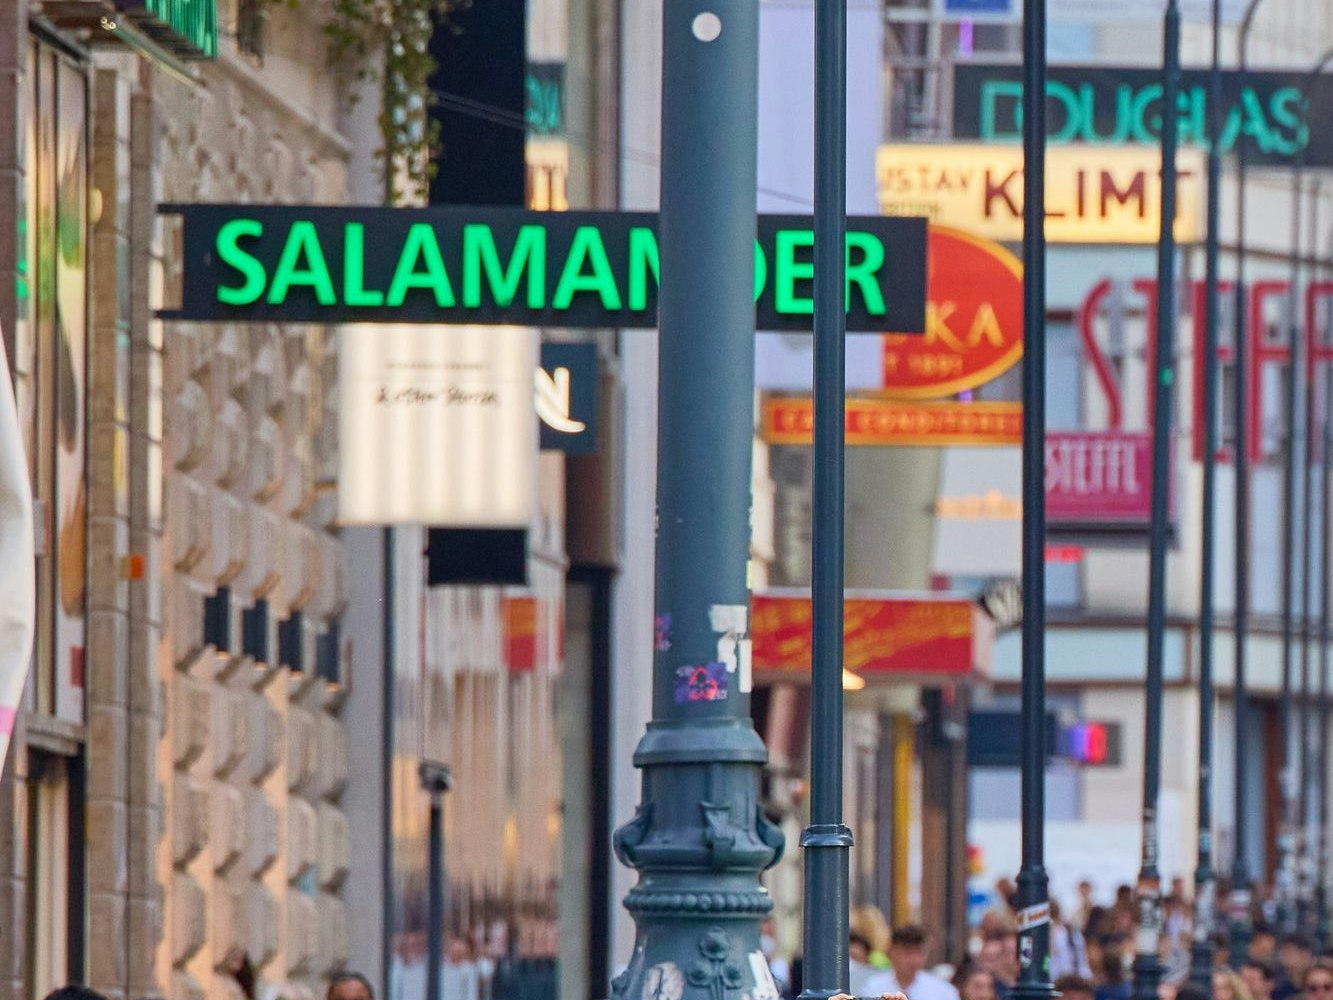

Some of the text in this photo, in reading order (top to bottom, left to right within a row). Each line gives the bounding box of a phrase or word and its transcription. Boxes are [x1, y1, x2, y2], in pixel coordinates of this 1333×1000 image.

[980, 80, 1309, 154] DOUGLAS
[985, 169, 1191, 218] KIMT
[215, 218, 887, 316] SALAMANER
